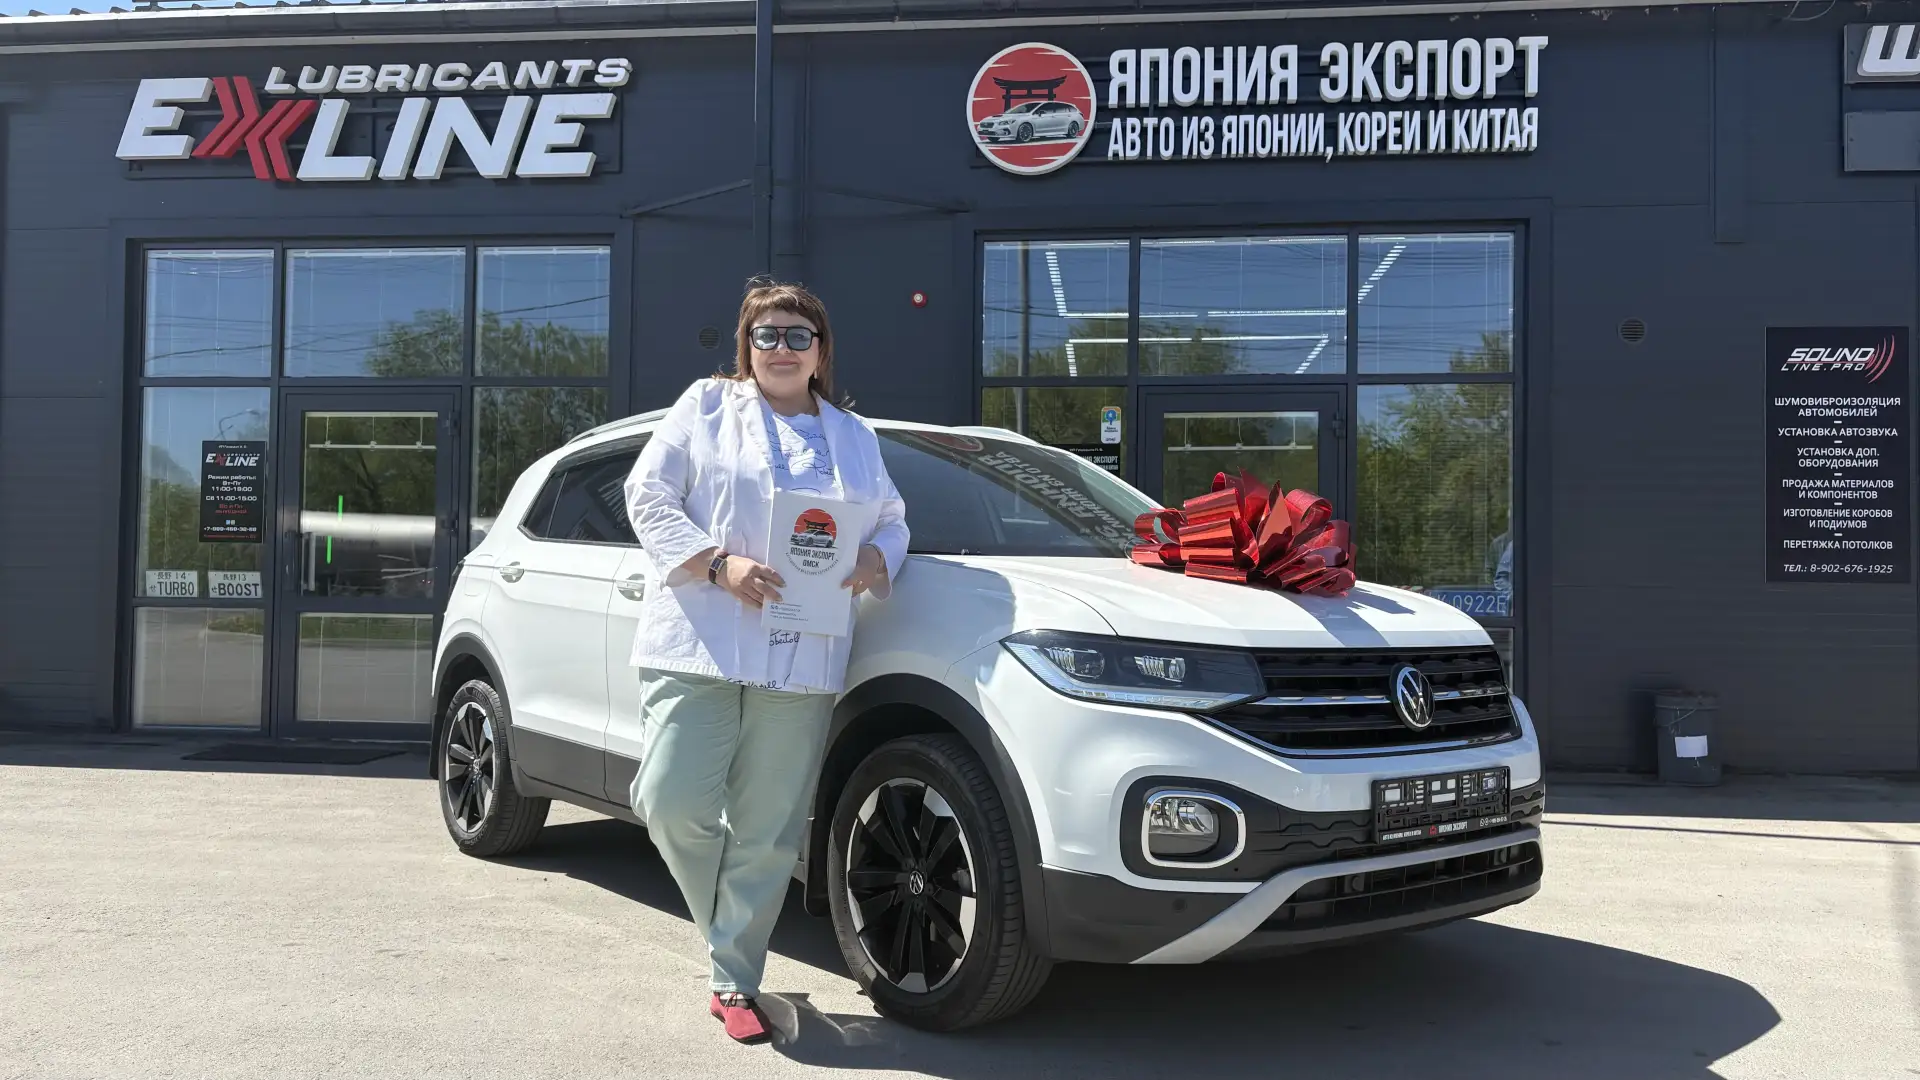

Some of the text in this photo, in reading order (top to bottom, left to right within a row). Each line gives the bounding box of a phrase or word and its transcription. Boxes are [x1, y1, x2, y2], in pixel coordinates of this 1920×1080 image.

[264, 58, 633, 94] LUBRICANTS
[1109, 35, 1549, 109] ЯПОНИЯ ЭКСПОРТ
[1108, 106, 1539, 163] АВТО ИЗ ЯПОНИИ, КОРЕИ И КИТАЯ
[1787, 347, 1875, 362] SOUND
[1774, 397, 1901, 407] ШУМОВИБРОИЗОЛЯЦИЯ
[1798, 406, 1878, 417] АВТОМОБИЛЕЙ
[1778, 427, 1898, 437] УСТАНОВКА АВТОЗВУКА
[1797, 447, 1880, 458] УСТАНОВКА ДОП.
[1798, 458, 1879, 469] ОБОРУДОВАНИЯ
[1782, 479, 1894, 489] ПРОДАЖА МАТЕРИАЛОВ
[1798, 490, 1878, 499] И КОМПОНЕНТОВ
[1783, 508, 1893, 518] ИЗГОТОВЛЕНИЕ КОРОБОВ
[1809, 519, 1868, 530] И ПОДИУМОВ
[1783, 539, 1893, 550] ПЕРЕТЯЖКА ПОТОЛКОВ
[802, 559, 820, 568] ОМСК
[1809, 563, 1894, 574] 8-902-676-1925
[157, 581, 195, 596] TURBO
[218, 583, 260, 597] BOOST
